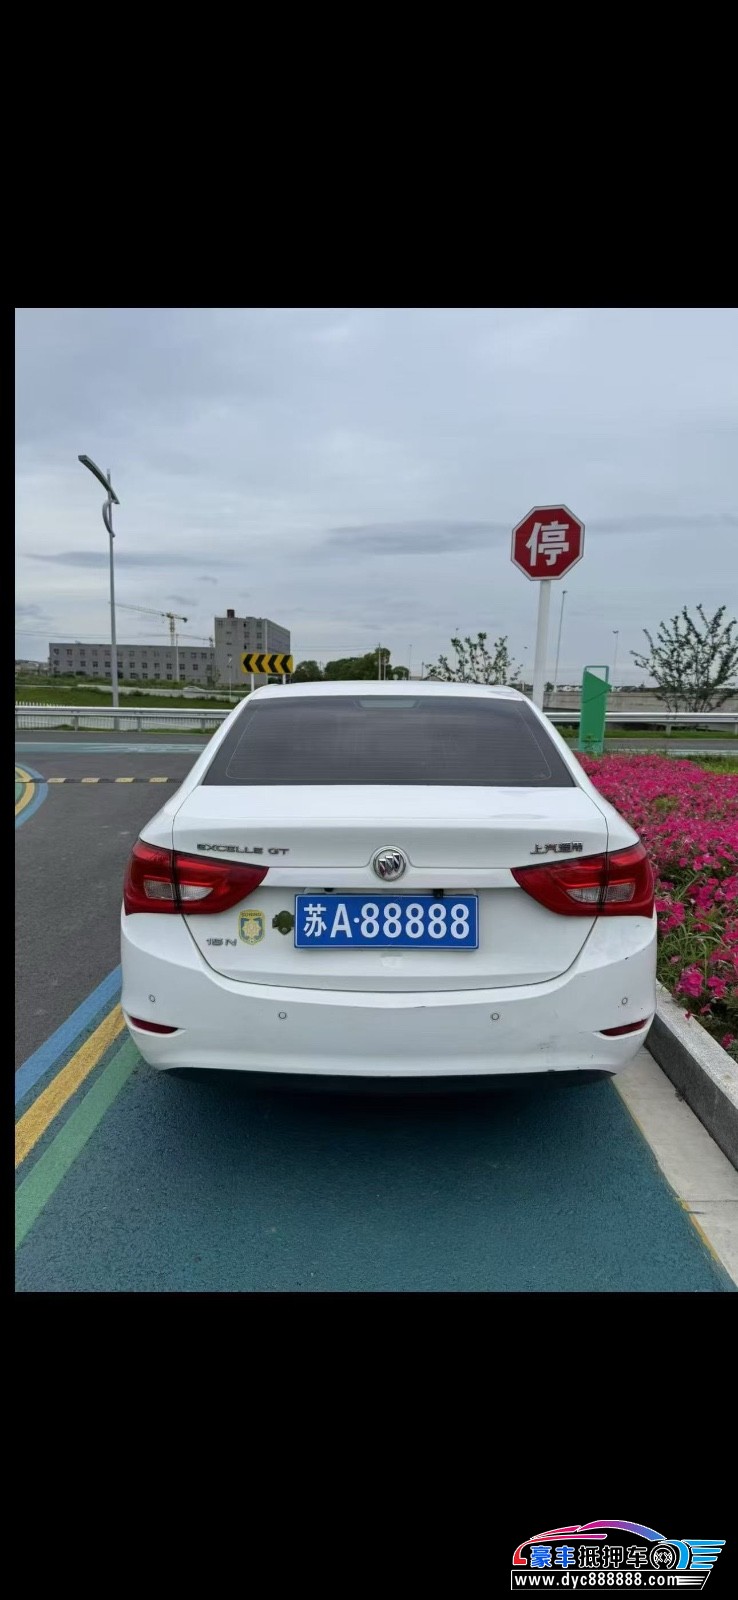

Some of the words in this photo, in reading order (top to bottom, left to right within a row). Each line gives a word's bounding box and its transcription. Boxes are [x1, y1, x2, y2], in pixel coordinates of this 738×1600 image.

[525, 520, 570, 567] 停
[197, 843, 263, 855] EXCELLE
[268, 847, 290, 856] GT
